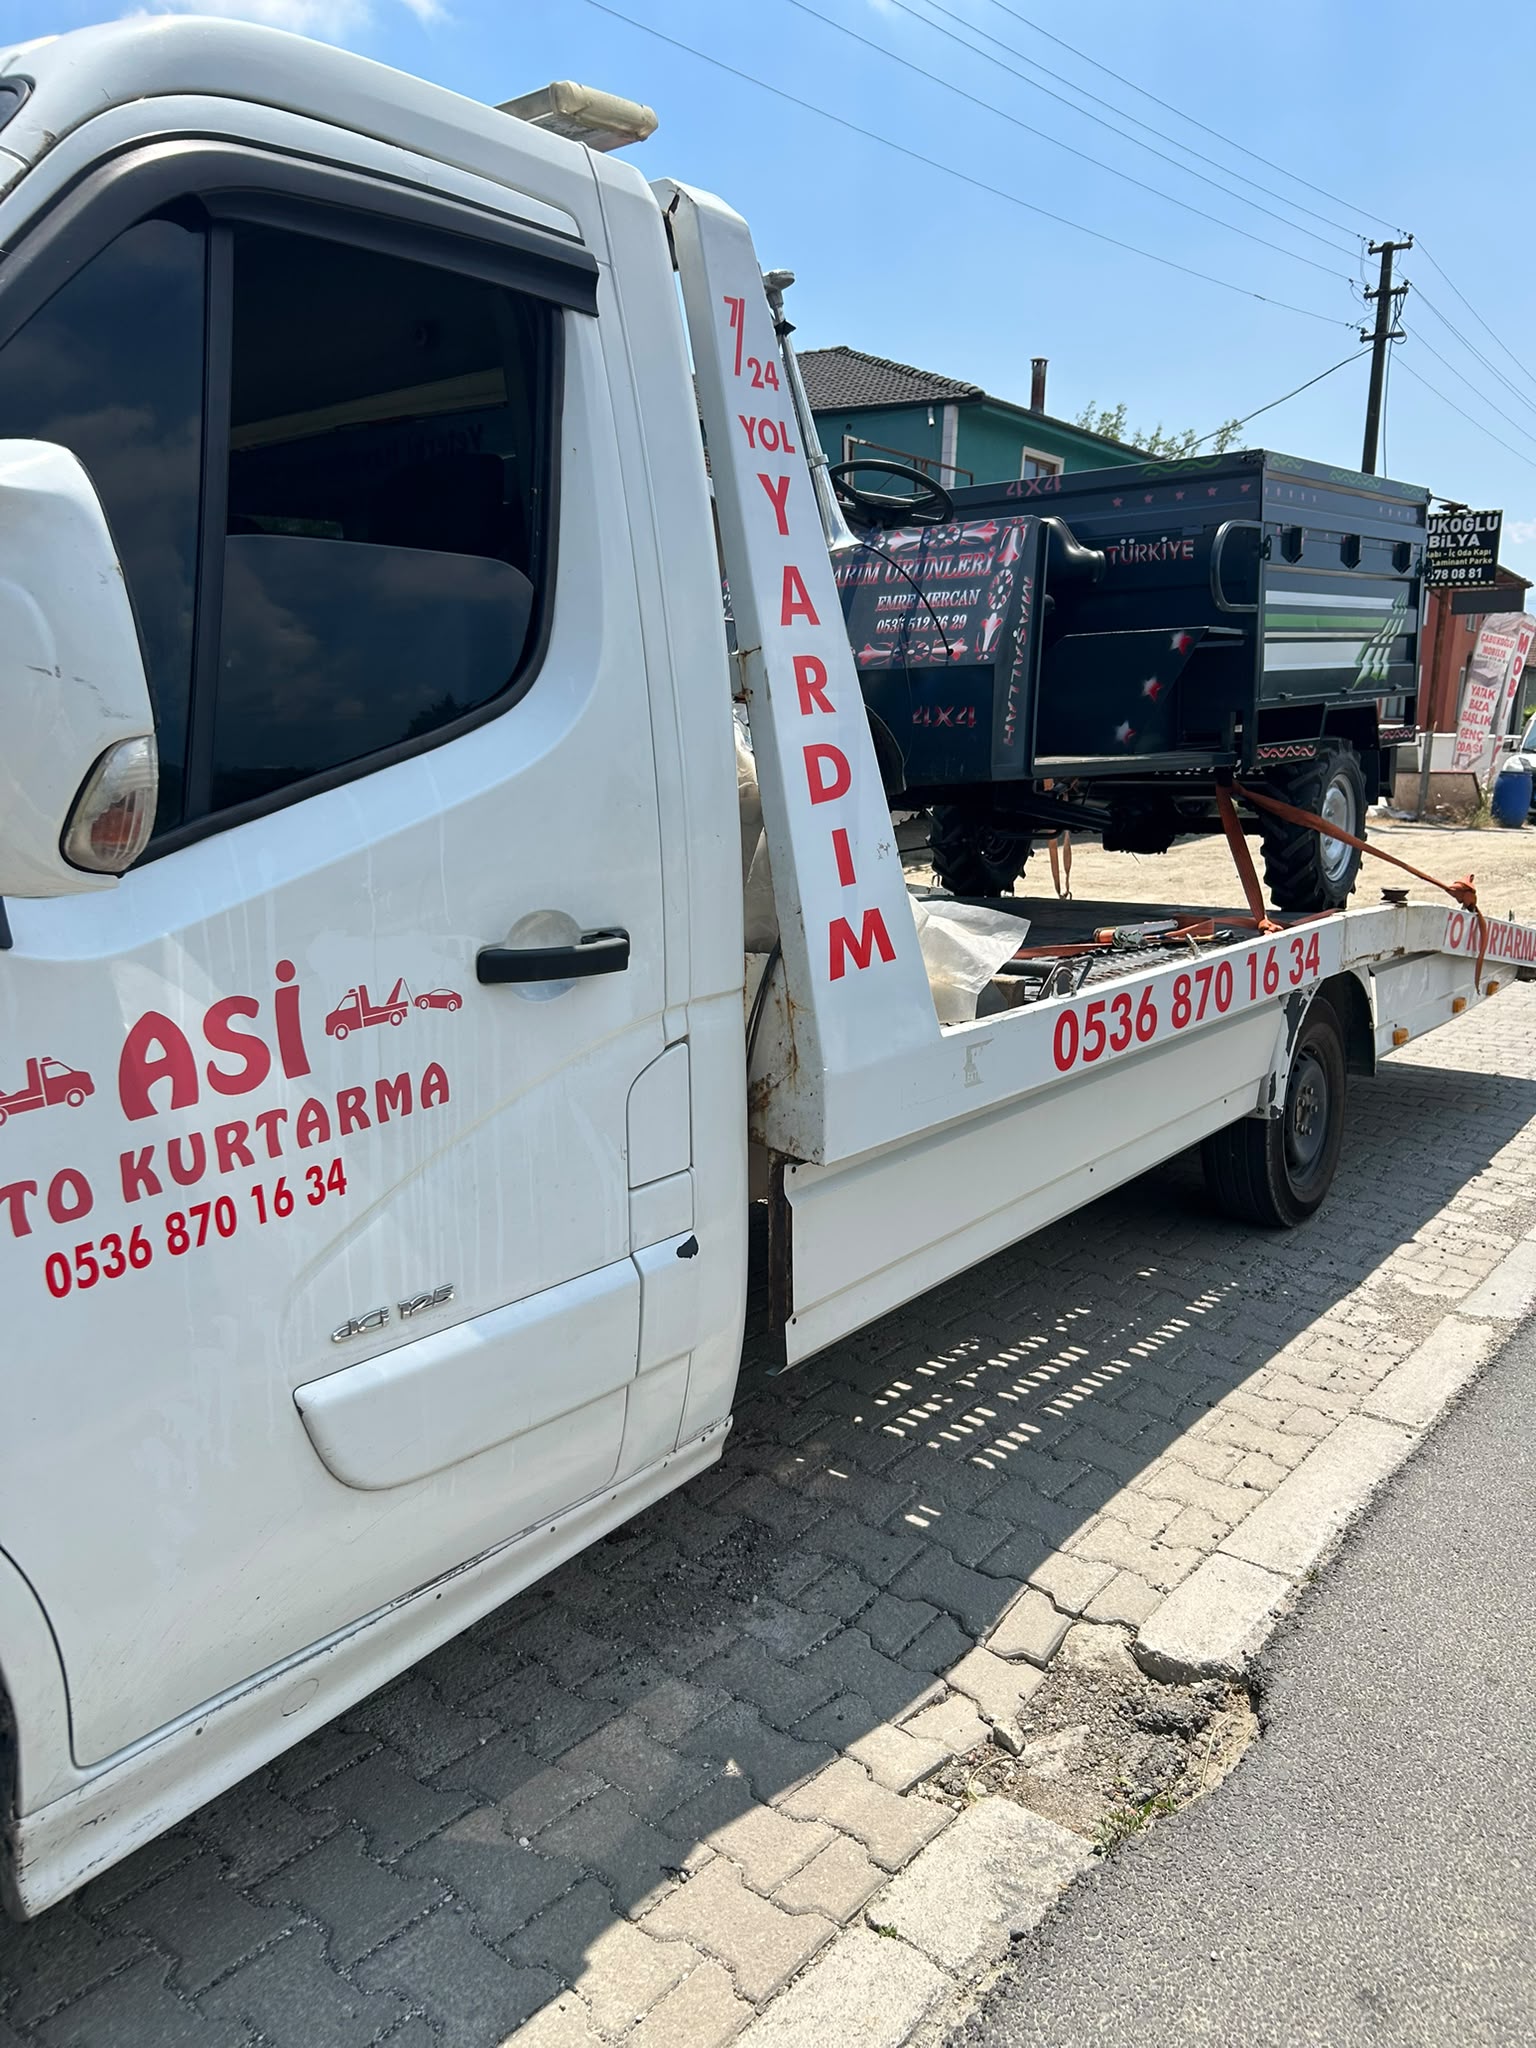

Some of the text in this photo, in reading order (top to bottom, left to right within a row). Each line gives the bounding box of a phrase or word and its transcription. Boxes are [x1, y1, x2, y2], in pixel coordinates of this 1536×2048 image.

[738, 415, 796, 454] YOL
[1107, 536, 1194, 566] TÜRKİYE
[1451, 568, 1466, 579] 08
[1468, 567, 1482, 578] 81
[875, 594, 916, 612] EMRE
[1469, 699, 1489, 712] BAZA
[1471, 685, 1496, 700] YATAK
[757, 473, 897, 982] YARDIM
[1053, 932, 1321, 1073] 0536 870 16 34
[118, 959, 312, 1122] ASİ
[0, 1062, 451, 1239] TO KURTARMA
[45, 1157, 348, 1299] 0536 870 16 34
[398, 1283, 455, 1320] 125
